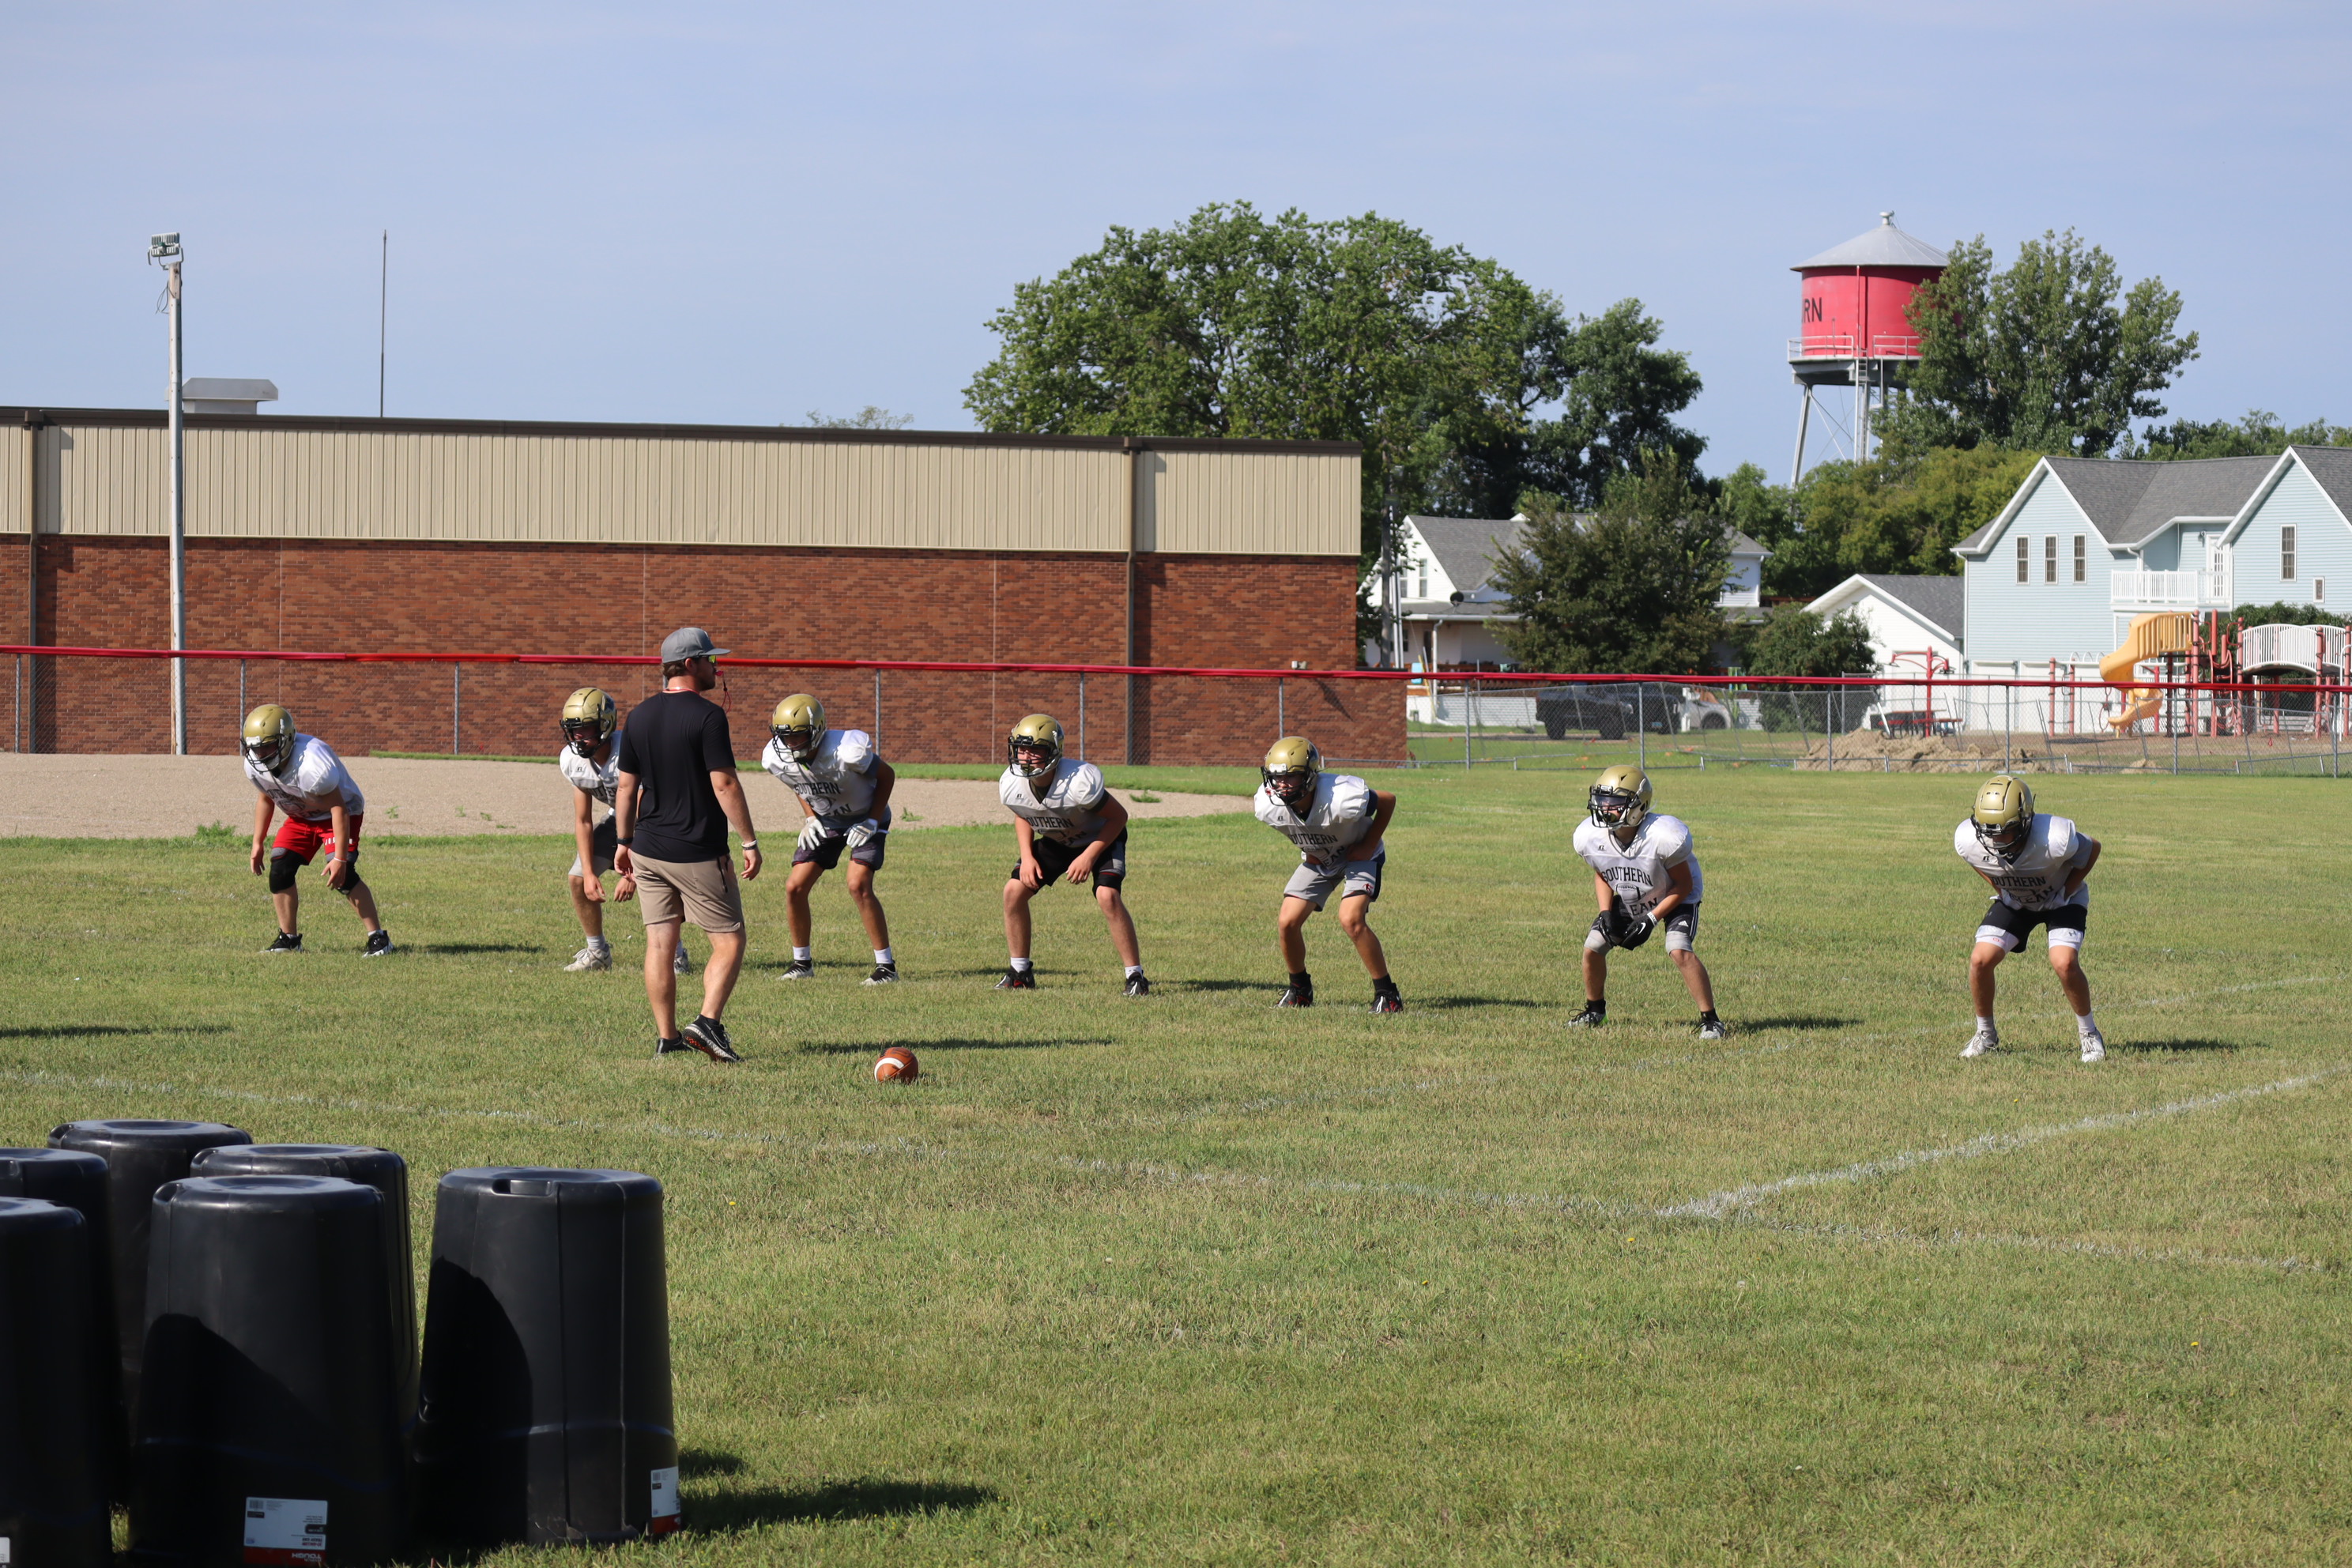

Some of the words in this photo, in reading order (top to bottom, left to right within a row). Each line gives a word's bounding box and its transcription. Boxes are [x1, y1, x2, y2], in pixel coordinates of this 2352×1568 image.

[793, 782, 841, 795] SOUTHERN
[1024, 816, 1075, 828] OUTHERN
[1287, 833, 1338, 845] OUTHERN
[1600, 866, 1654, 887] SOUTHERN
[1989, 876, 2046, 887] OUTHERN
